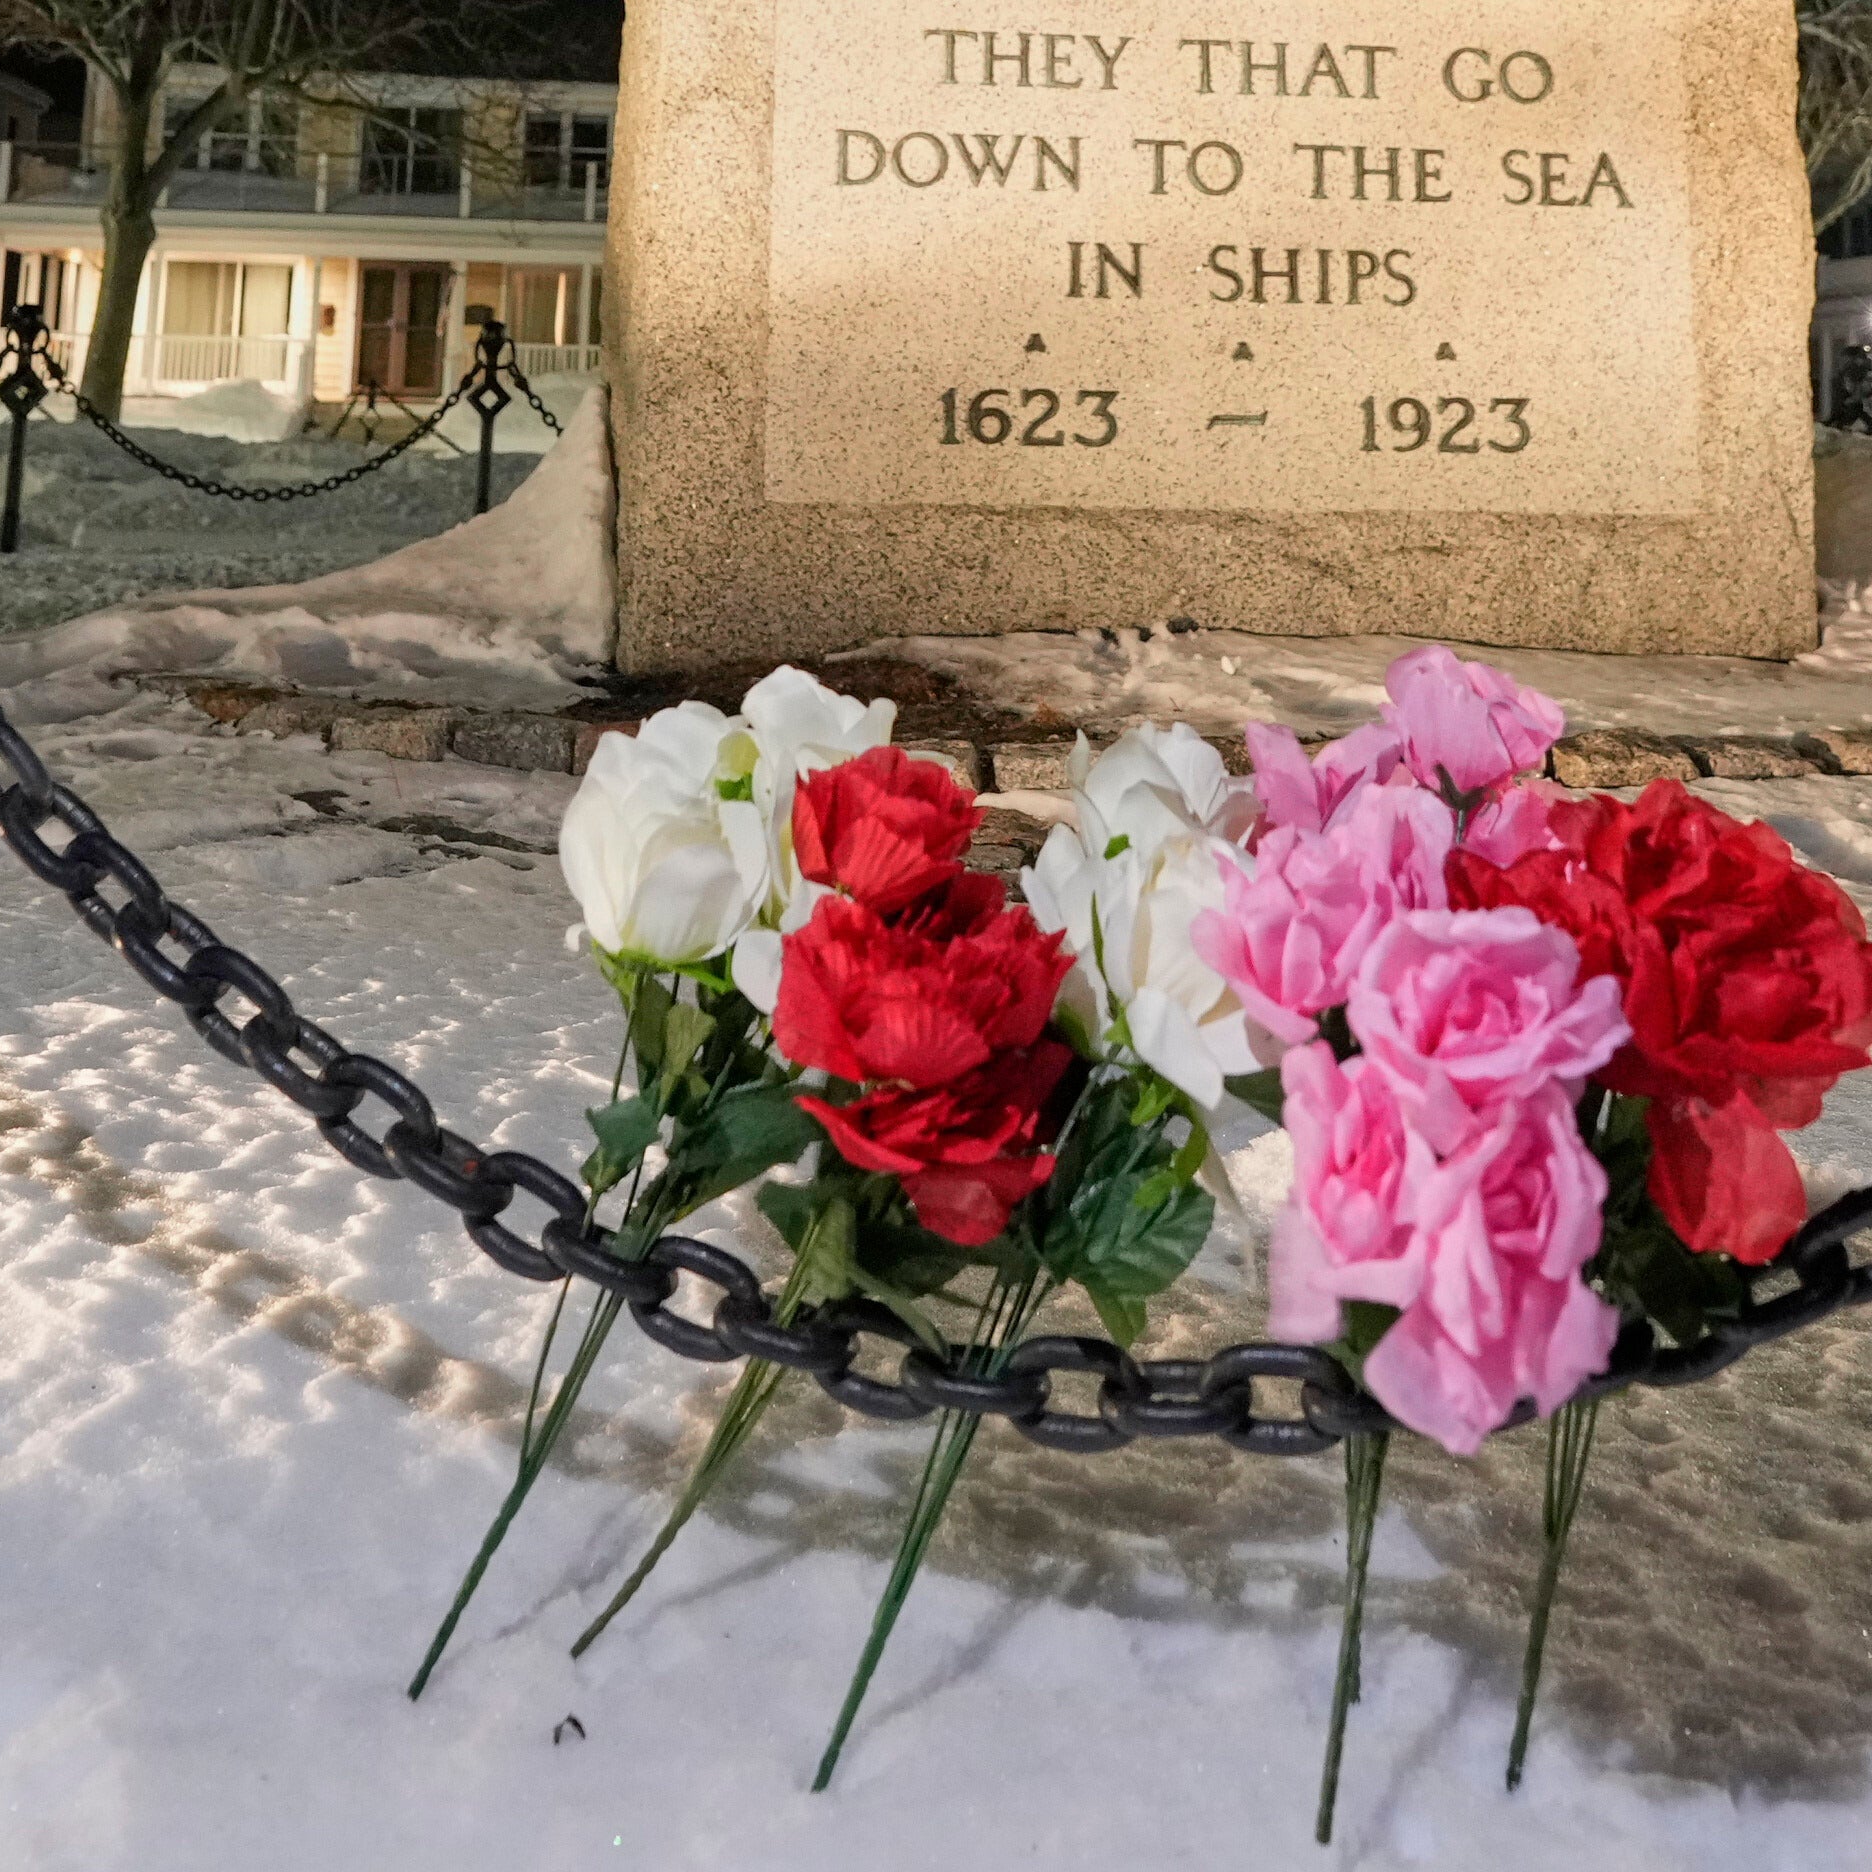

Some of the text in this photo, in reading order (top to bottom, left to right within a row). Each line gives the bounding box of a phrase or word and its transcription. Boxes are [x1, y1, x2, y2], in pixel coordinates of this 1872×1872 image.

[925, 29, 1555, 104] THEY THAT GO
[835, 130, 1634, 209] DOWN TO THE SEA
[1066, 241, 1416, 306] IN SHIPS
[940, 387, 1119, 448] 1623
[1358, 397, 1531, 453] 1923
